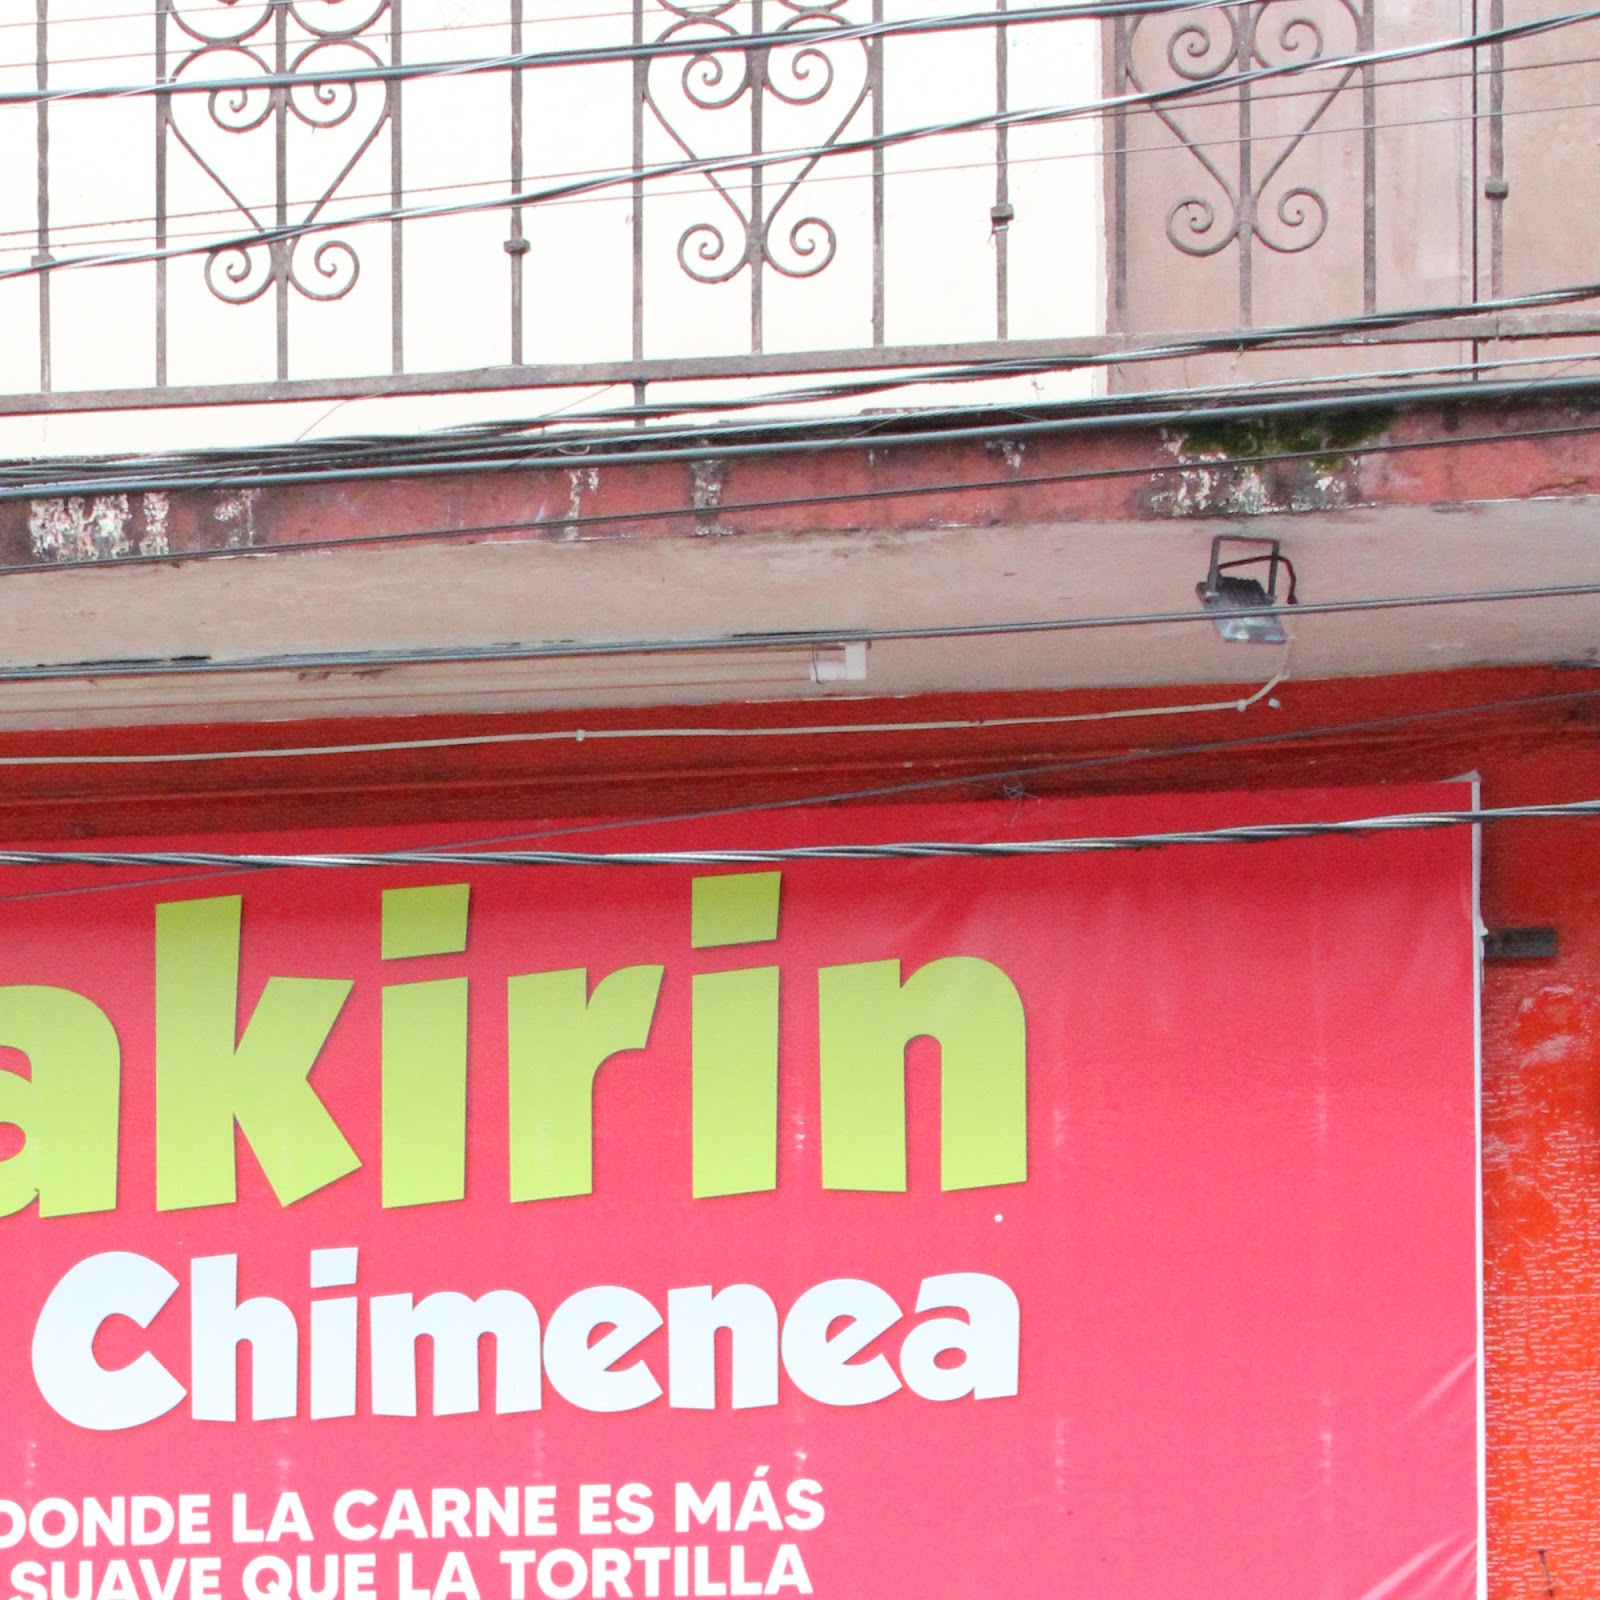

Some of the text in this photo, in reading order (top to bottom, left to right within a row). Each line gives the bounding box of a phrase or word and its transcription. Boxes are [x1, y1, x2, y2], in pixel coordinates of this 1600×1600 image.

[30, 1245, 1022, 1432] Chimenea
[231, 1491, 315, 1544] LA
[332, 1485, 559, 1543] CARNE
[578, 1482, 656, 1536] ES
[674, 1465, 826, 1534] MÁS
